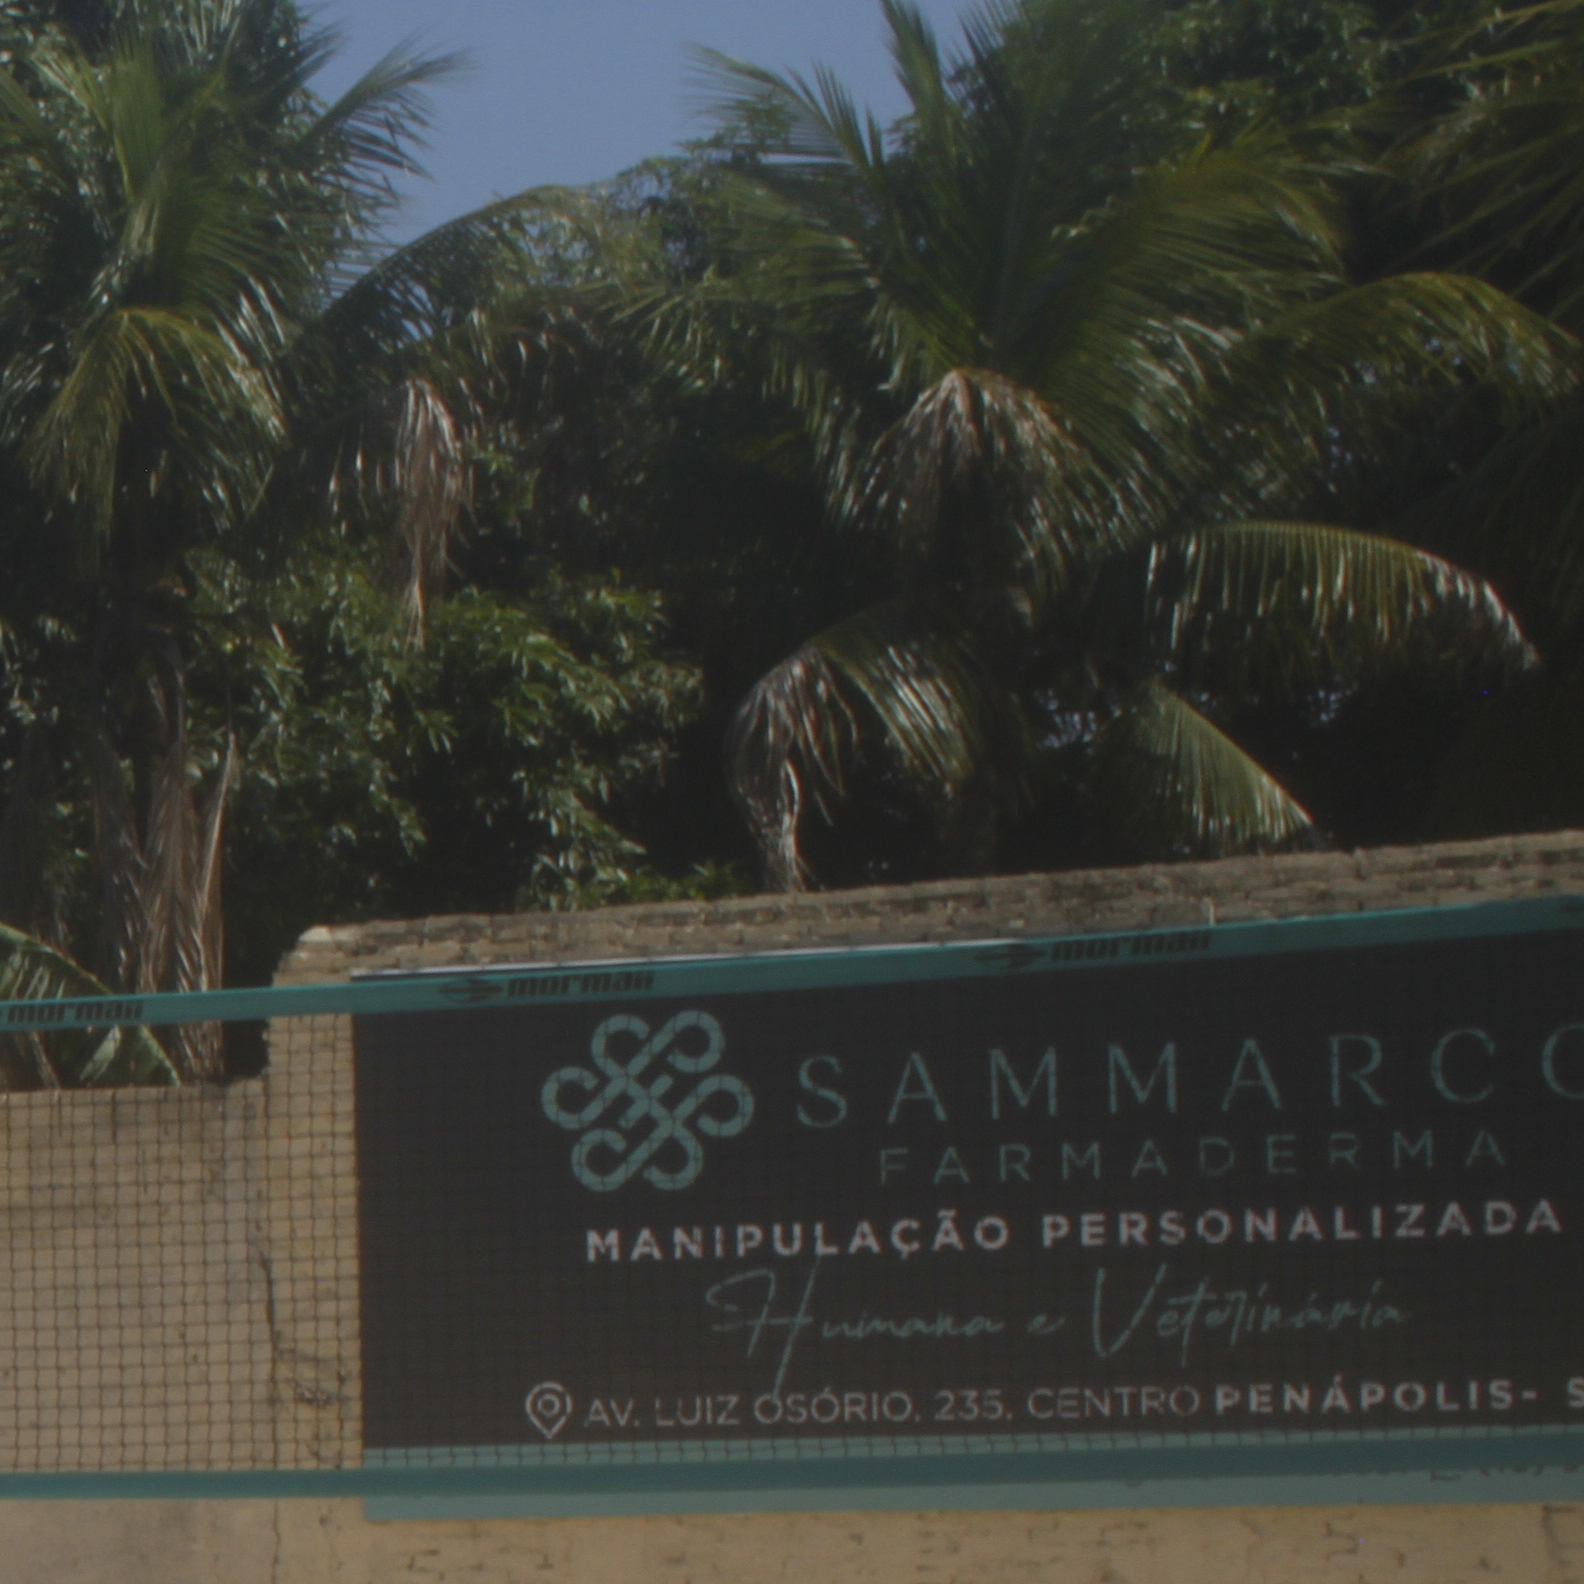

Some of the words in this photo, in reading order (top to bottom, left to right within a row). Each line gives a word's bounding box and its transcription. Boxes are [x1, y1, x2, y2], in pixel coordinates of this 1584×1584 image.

[878, 1130, 1506, 1187] FARMADERMA
[585, 1209, 1010, 1263] MANIPULAÇÃO
[1041, 1198, 1563, 1249] PERSONALIZADA
[705, 1256, 1008, 1396] Humana
[1028, 1313, 1066, 1337] e
[1092, 1262, 1412, 1368] Veterinária
[583, 1398, 640, 1428] AV.
[655, 1394, 741, 1427] LUIZ
[1027, 1385, 1201, 1419] CENTRO
